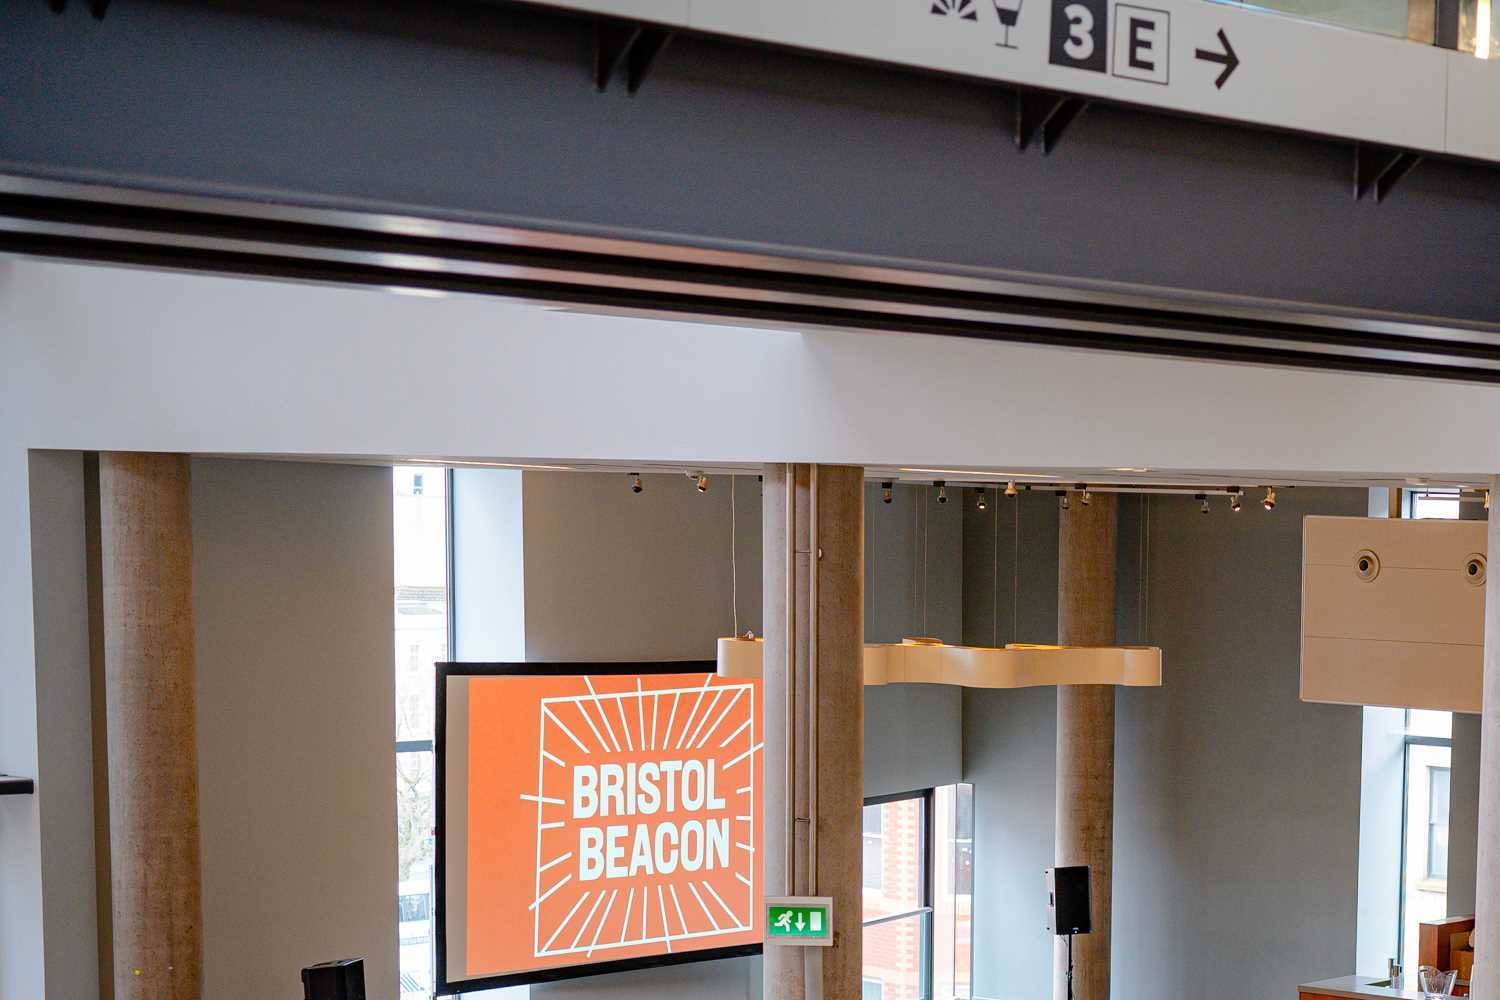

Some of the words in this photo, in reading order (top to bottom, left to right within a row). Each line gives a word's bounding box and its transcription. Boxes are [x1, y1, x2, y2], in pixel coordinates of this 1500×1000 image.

[1063, 3, 1094, 60] 3
[1129, 17, 1155, 71] E
[572, 759, 726, 819] BRISTOL
[579, 818, 730, 881] BEACON
